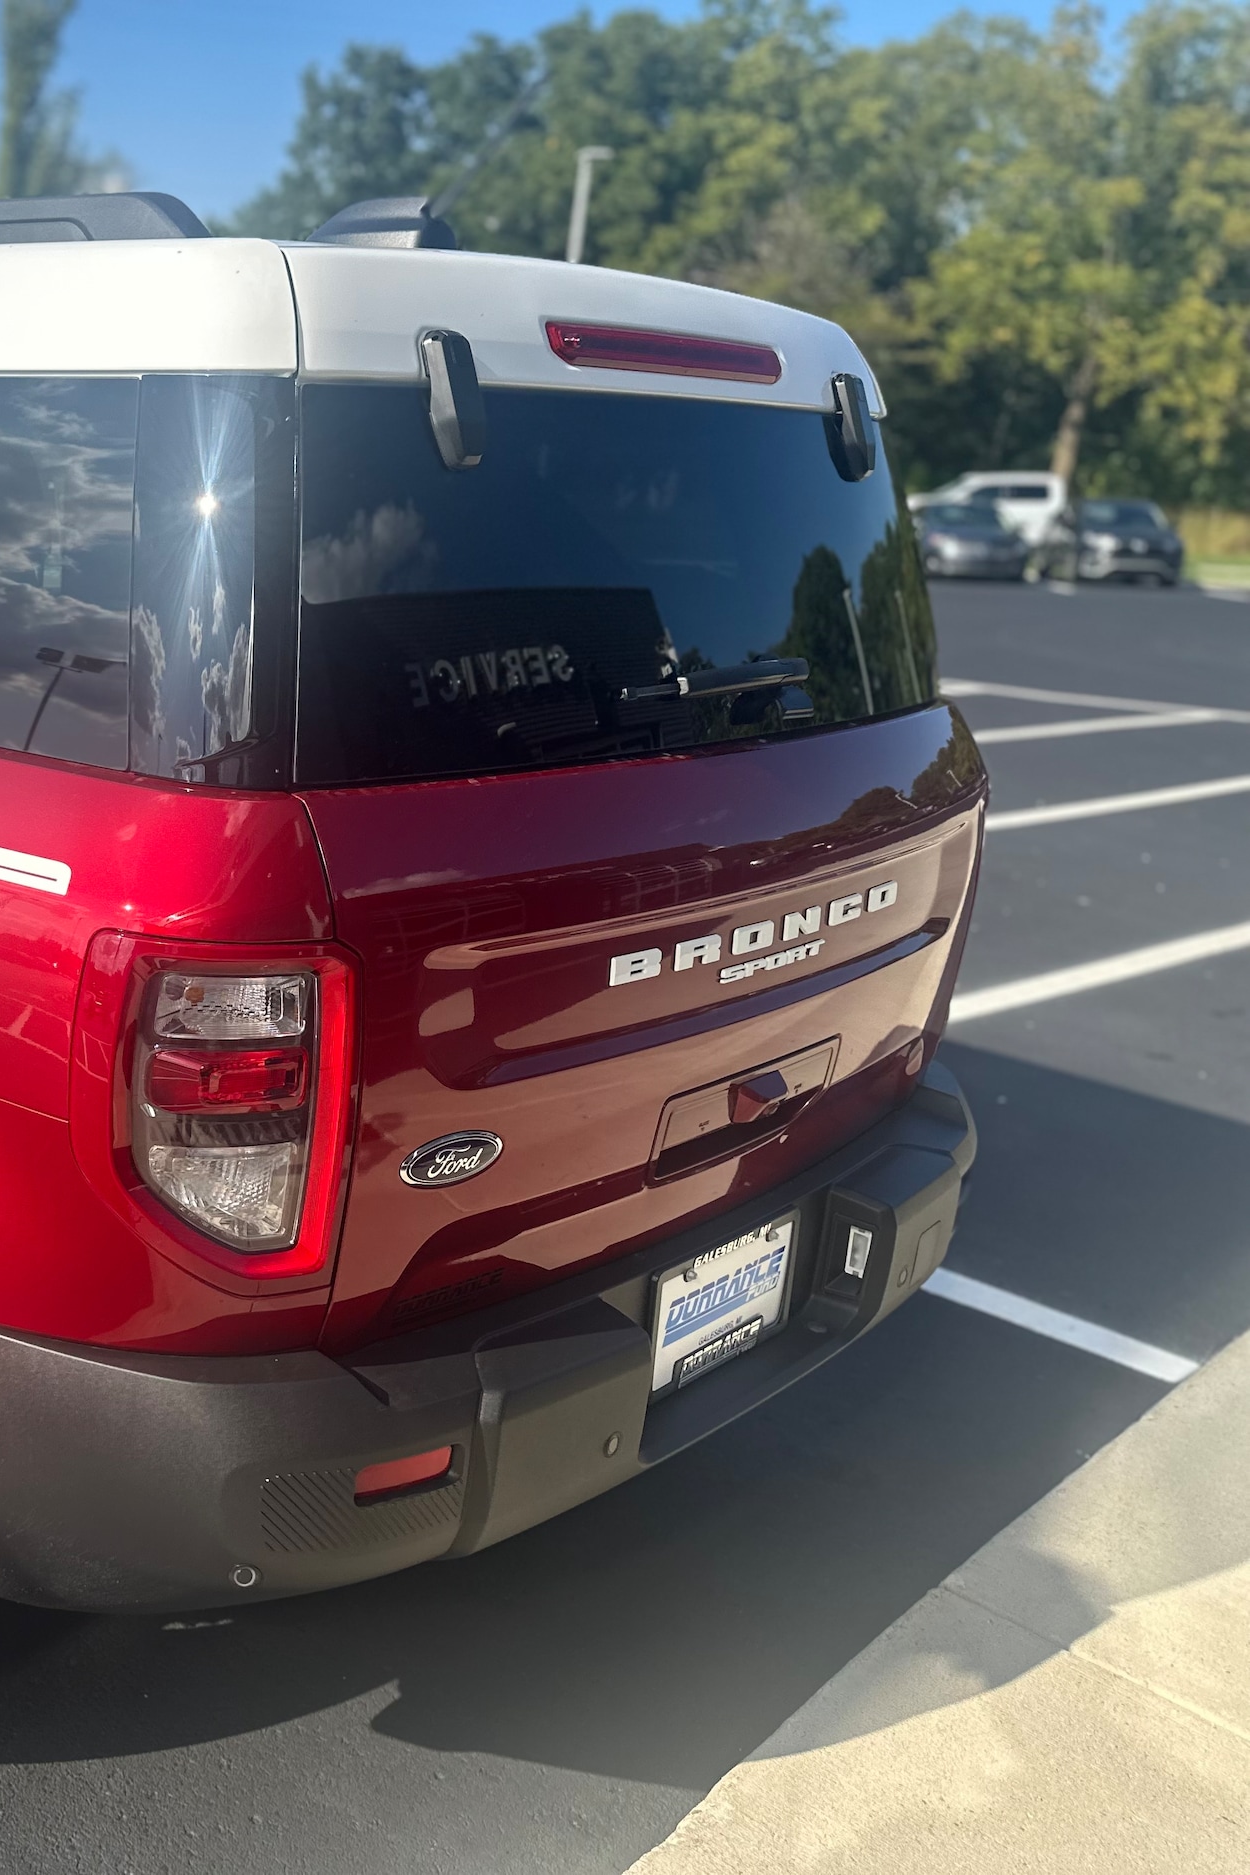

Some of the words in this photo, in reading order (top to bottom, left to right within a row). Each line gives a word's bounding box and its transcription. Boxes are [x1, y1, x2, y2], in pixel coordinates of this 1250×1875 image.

[608, 880, 899, 987] BRONCO
[719, 938, 826, 984] SPORT
[427, 1144, 484, 1179] Ford
